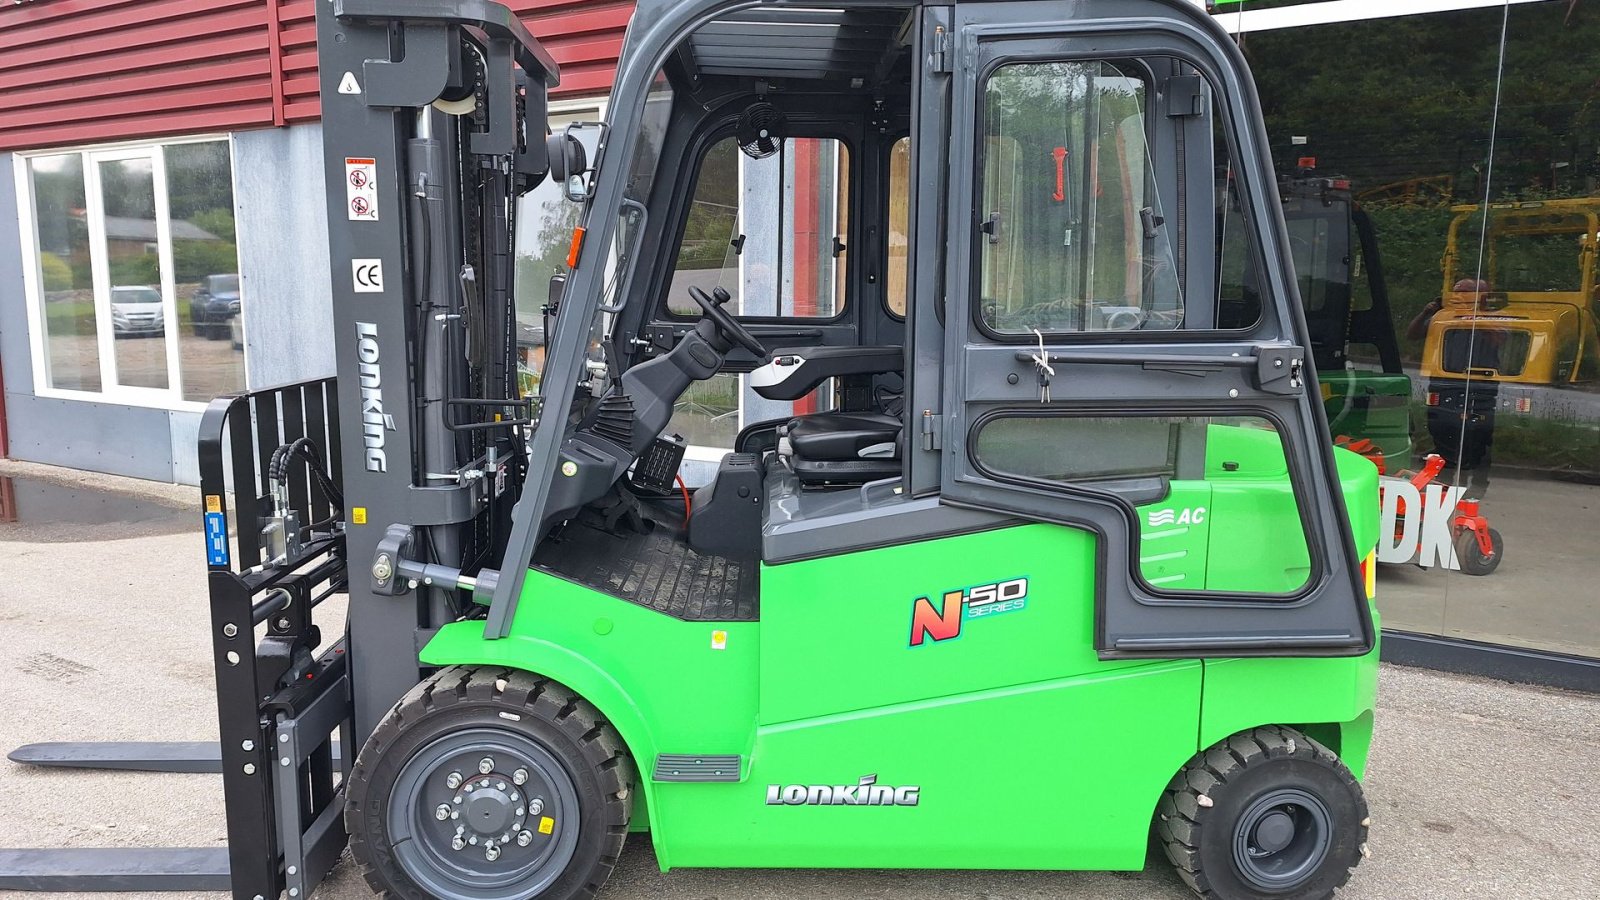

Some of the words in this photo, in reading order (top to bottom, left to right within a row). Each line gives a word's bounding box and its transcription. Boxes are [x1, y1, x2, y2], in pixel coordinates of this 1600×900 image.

[357, 265, 380, 286] CE
[355, 321, 397, 473] LONKING
[1176, 507, 1206, 525] AC
[968, 600, 1025, 618] SERIES
[766, 774, 920, 806] LONKING
